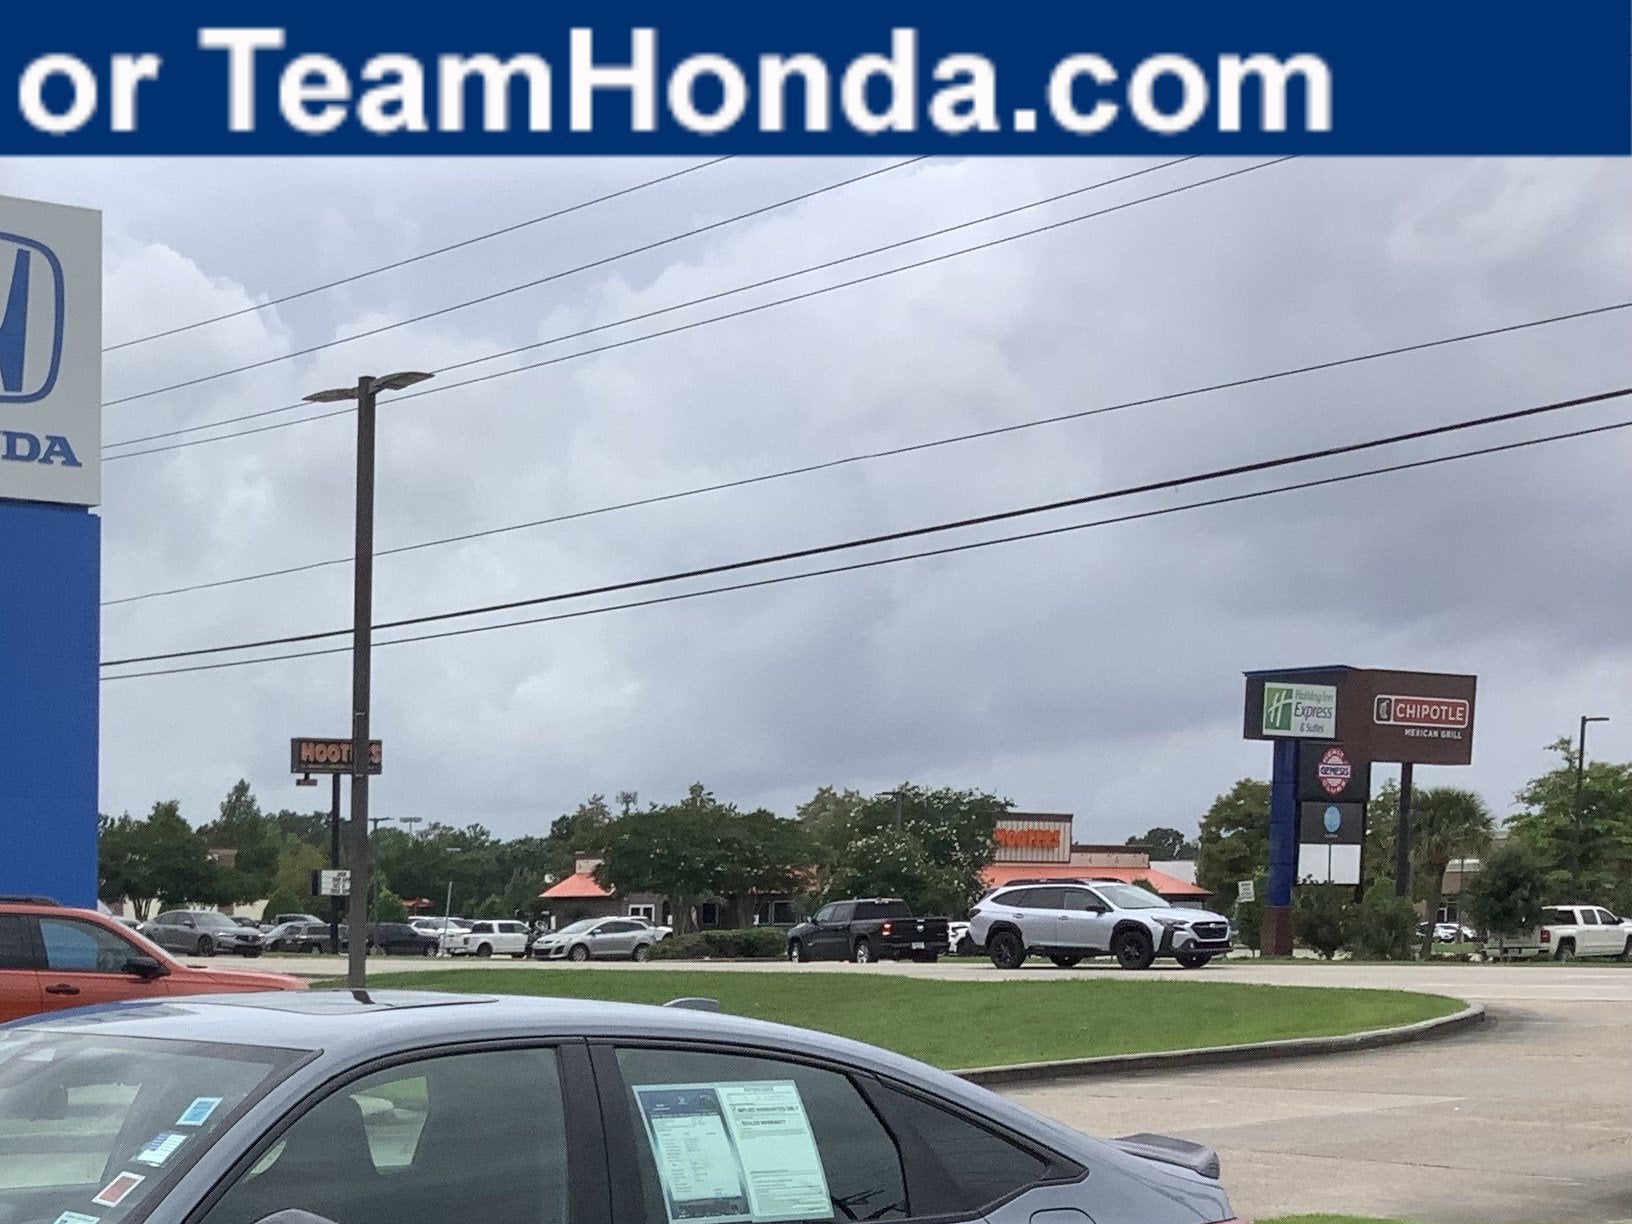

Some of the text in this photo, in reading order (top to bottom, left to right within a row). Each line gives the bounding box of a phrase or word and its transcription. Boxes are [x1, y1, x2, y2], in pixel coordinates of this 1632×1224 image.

[1294, 702, 1333, 720] Express
[1396, 703, 1465, 721] CHIPOTLE
[1404, 728, 1462, 740] MEXICAN GRILL
[304, 742, 381, 764] HOOTS
[1320, 766, 1349, 776] GENESIS
